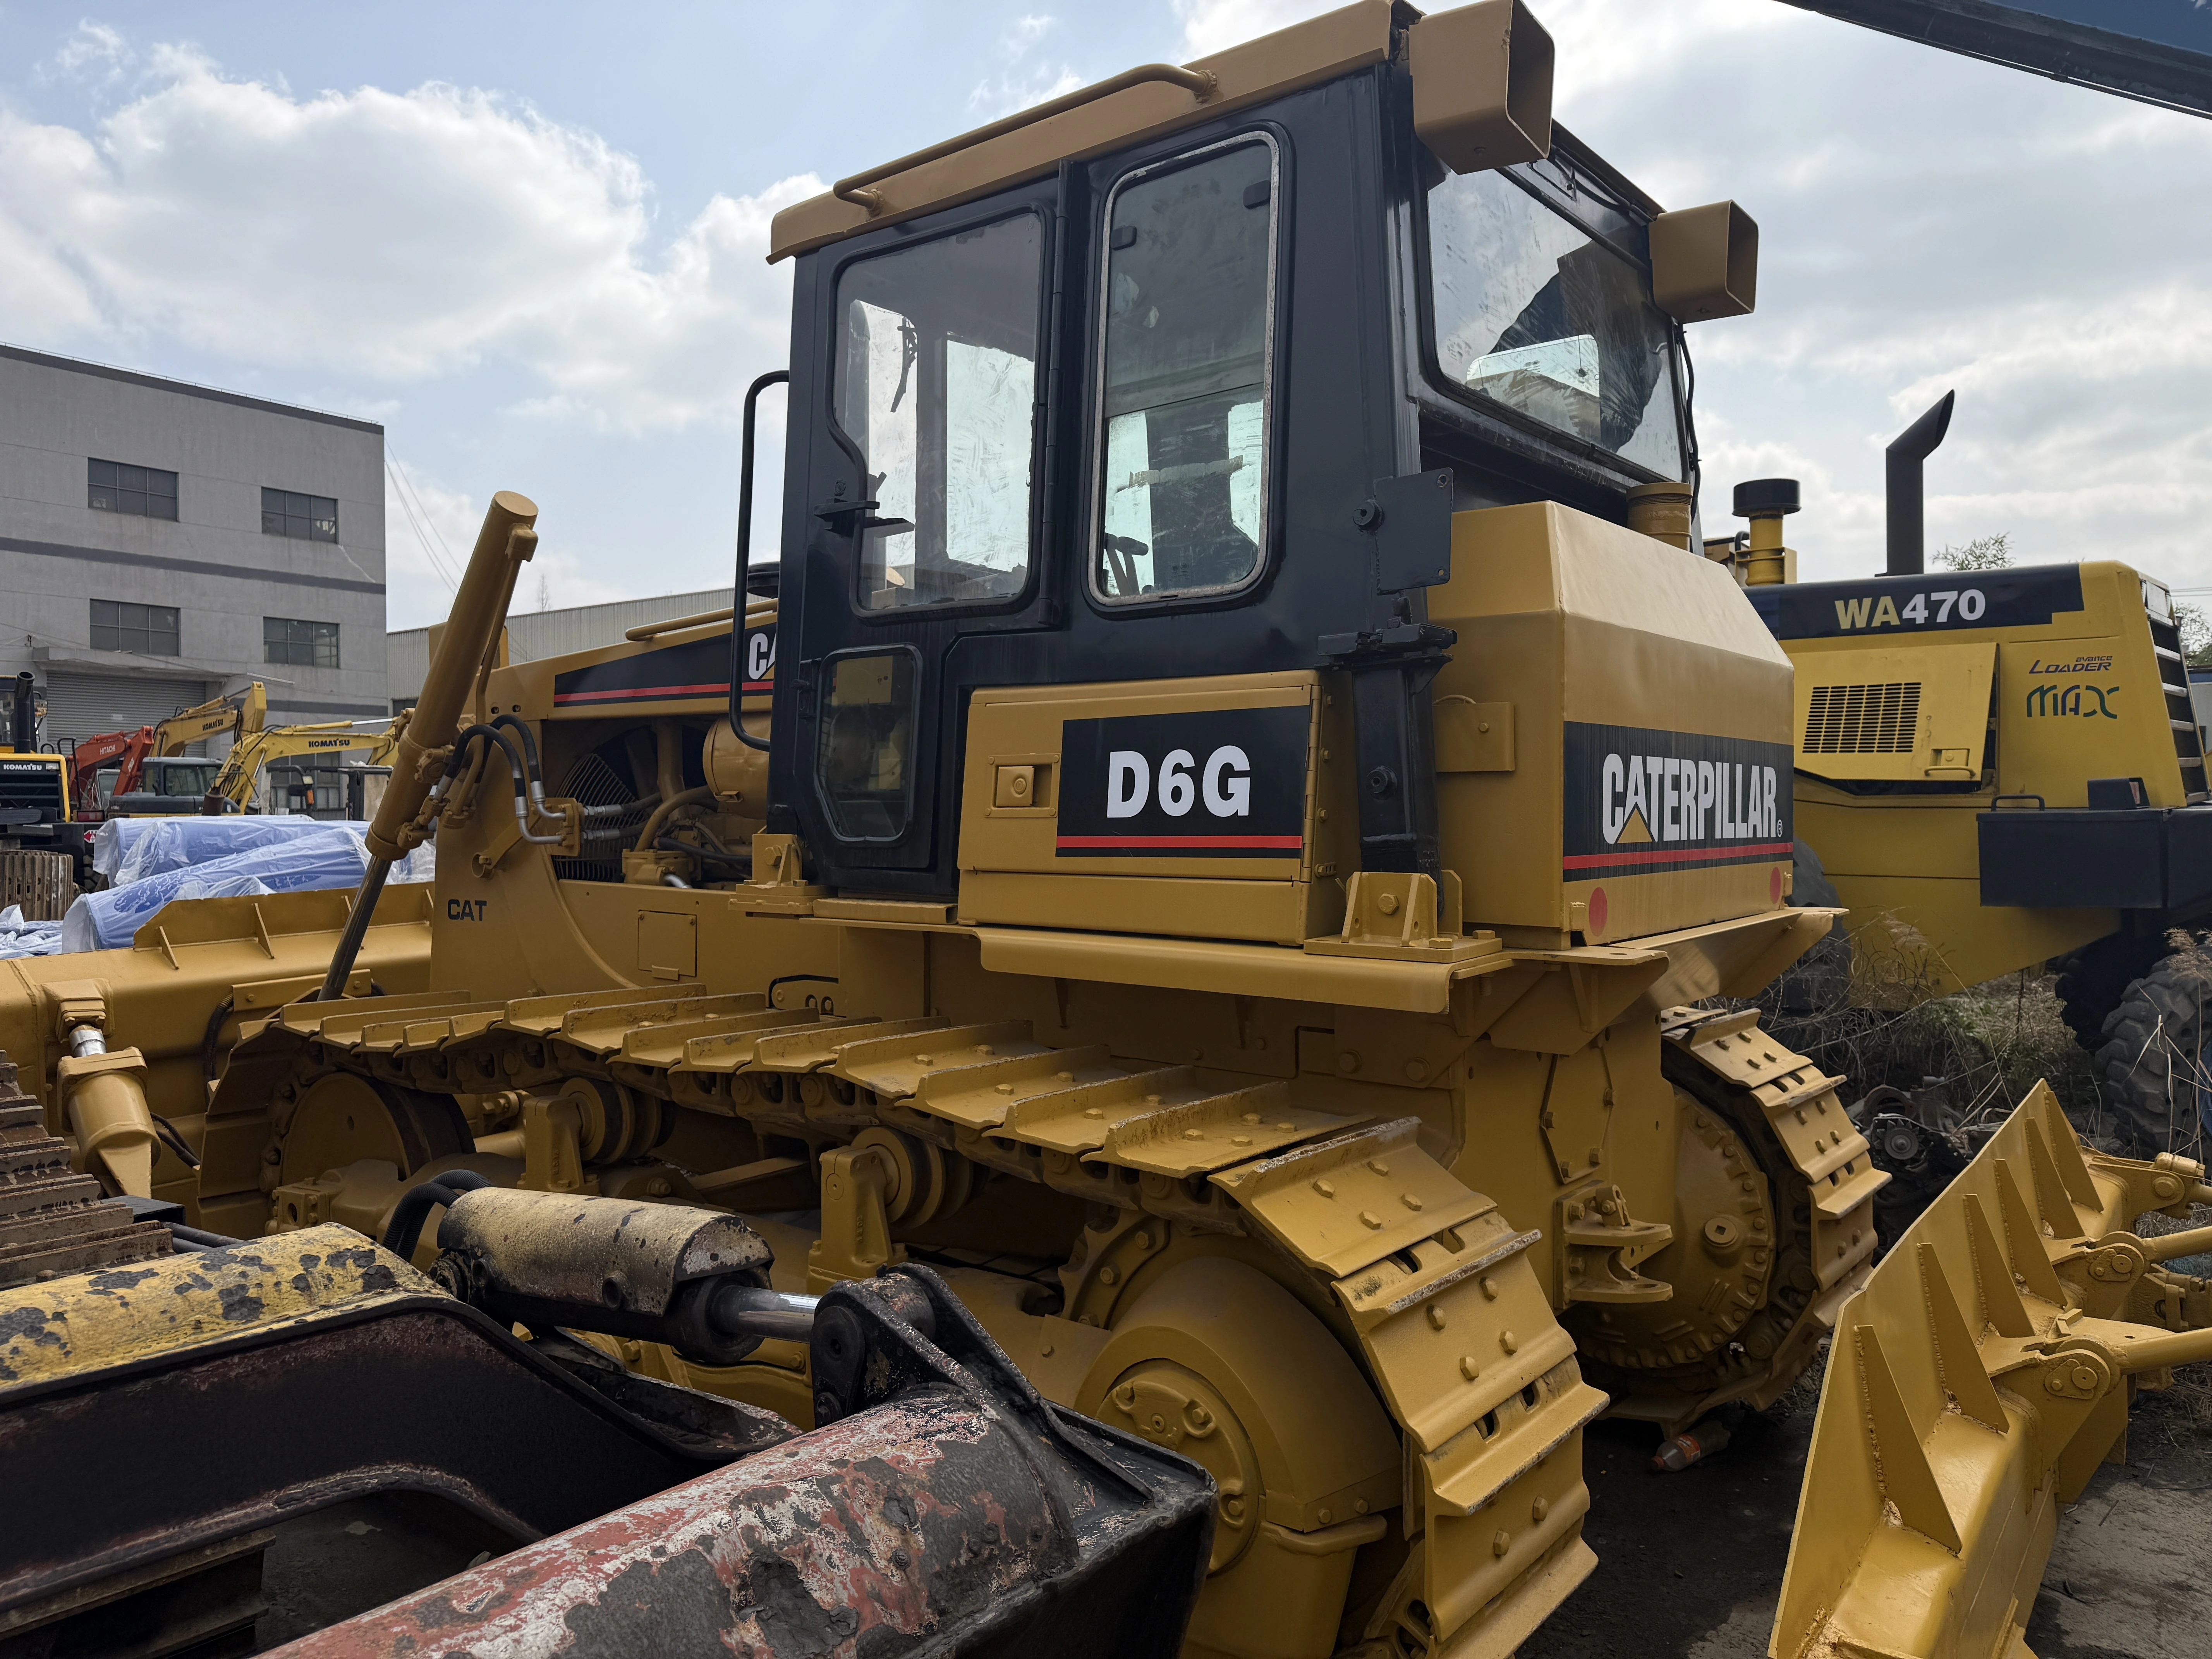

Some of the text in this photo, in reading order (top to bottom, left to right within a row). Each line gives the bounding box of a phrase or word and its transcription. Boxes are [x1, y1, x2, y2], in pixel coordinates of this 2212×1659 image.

[1835, 589, 1985, 629] WA470
[2029, 660, 2112, 674] LOADER
[2027, 685, 2119, 719] MAX
[202, 718, 223, 731] KOMATSU
[100, 744, 115, 755] HITACHI
[309, 737, 350, 747] KOMATSU
[1107, 745, 1250, 818] D6G
[1602, 753, 1777, 844] CATERPILLAR
[448, 899, 487, 921] CAT
